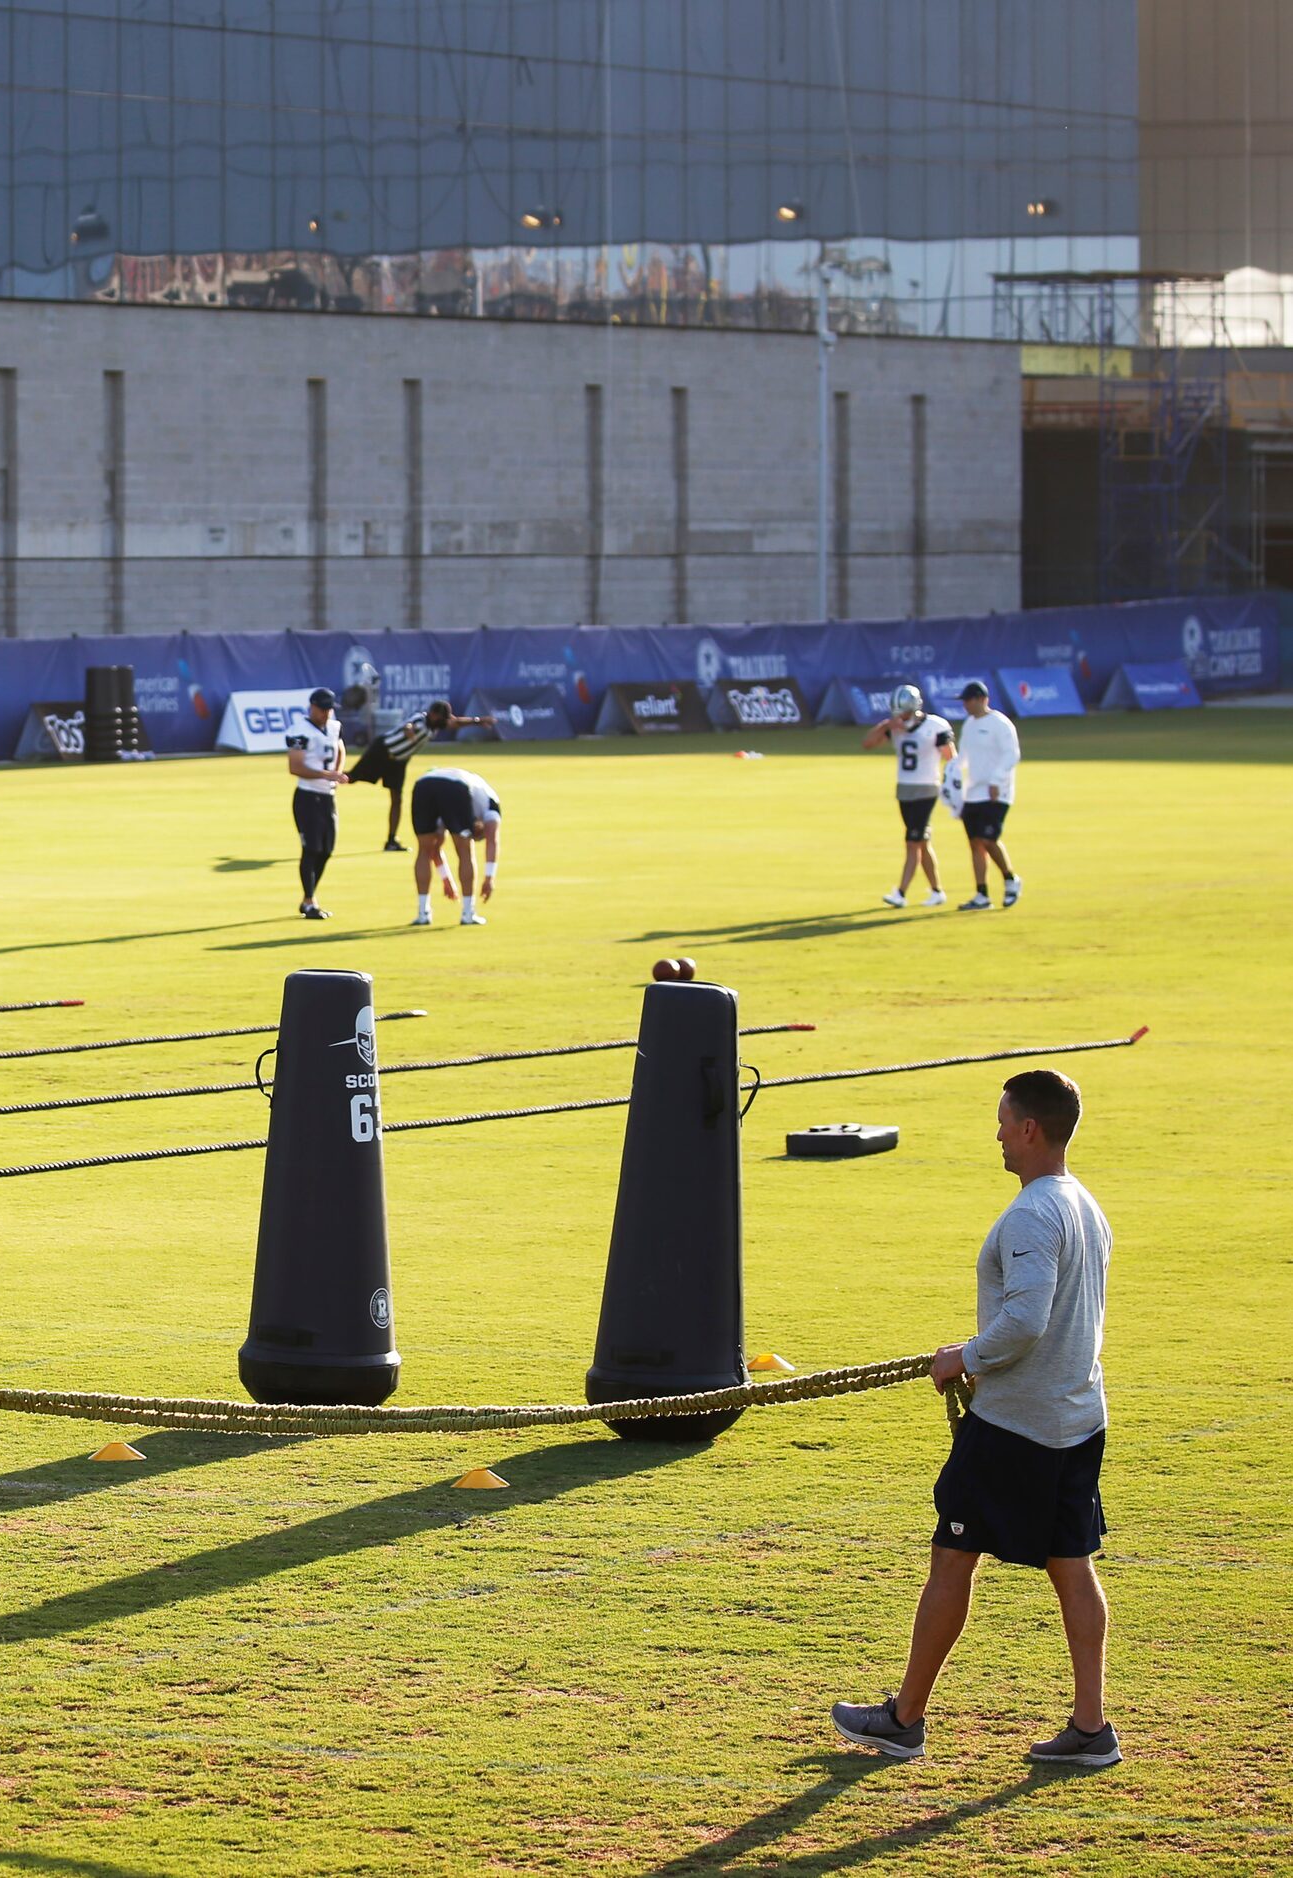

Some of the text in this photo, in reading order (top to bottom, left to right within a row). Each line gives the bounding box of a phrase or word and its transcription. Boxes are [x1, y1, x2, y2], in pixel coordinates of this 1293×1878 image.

[134, 675, 179, 692] merican
[633, 694, 679, 719] reliant
[900, 740, 919, 771] 6
